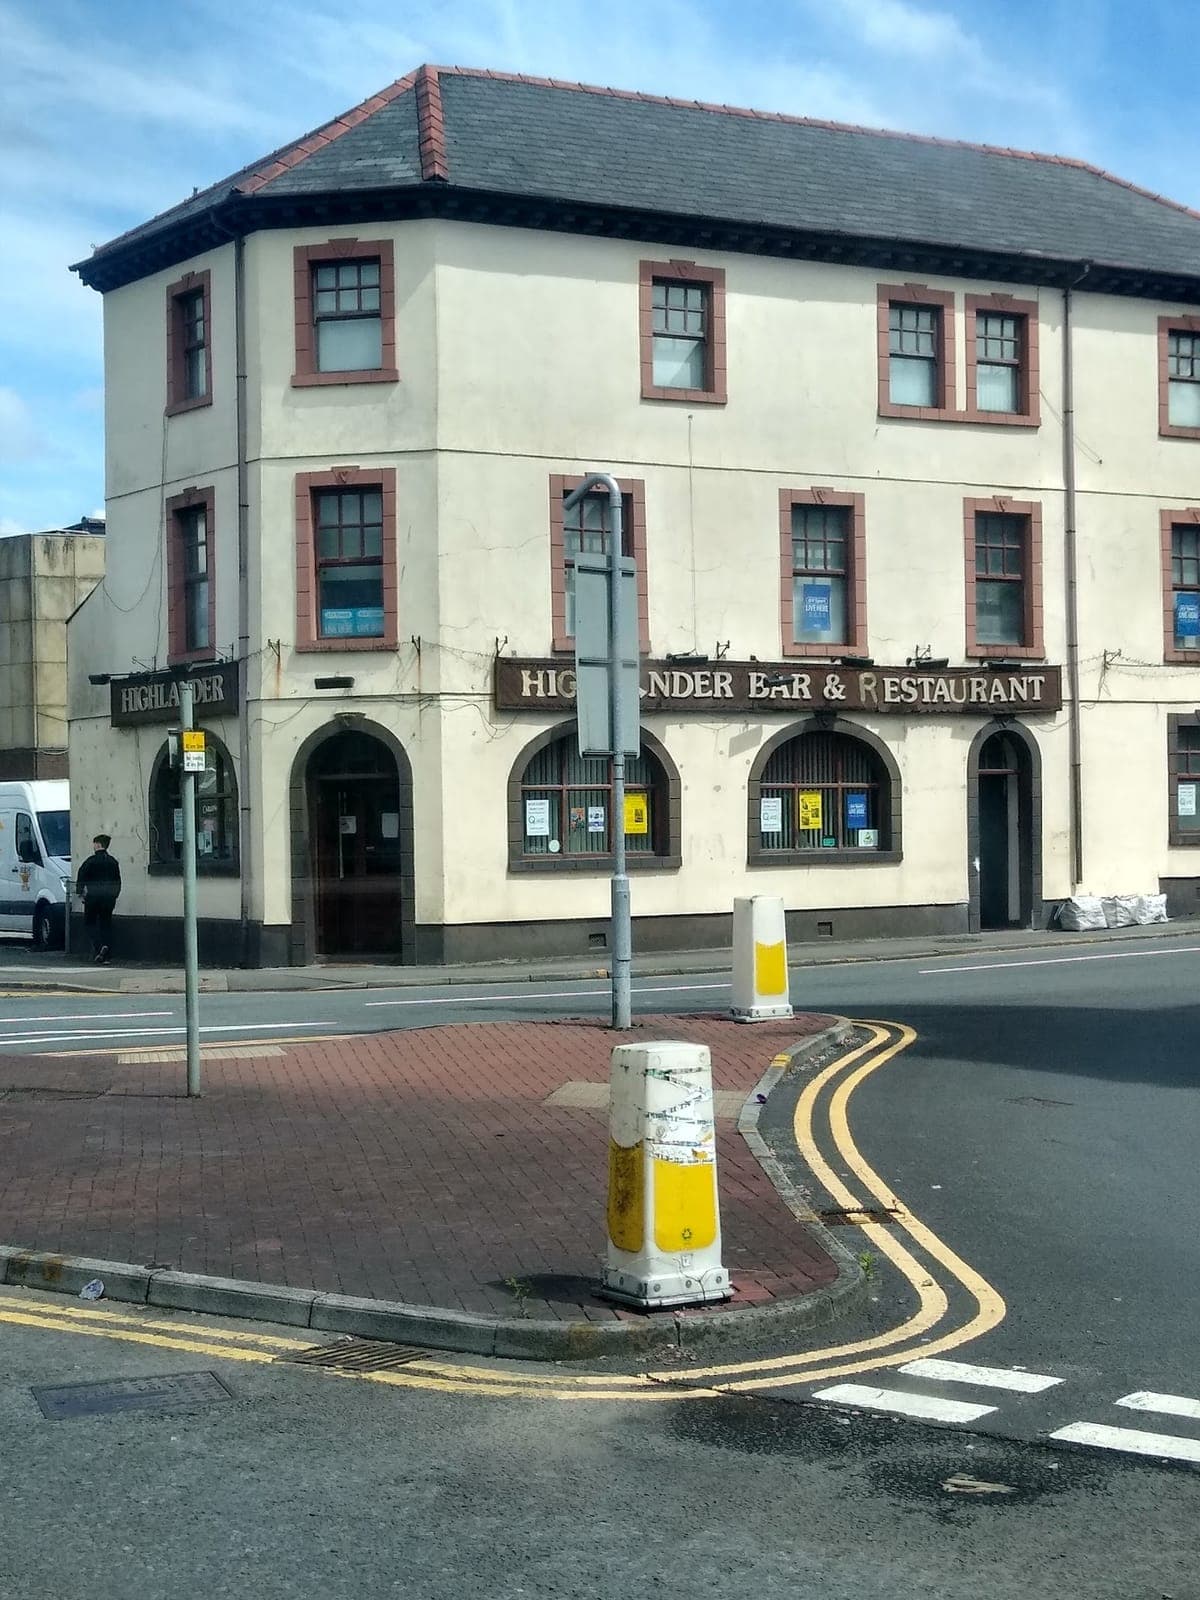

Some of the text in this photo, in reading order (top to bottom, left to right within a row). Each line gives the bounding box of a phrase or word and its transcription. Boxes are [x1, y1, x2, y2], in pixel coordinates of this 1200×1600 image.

[121, 674, 225, 713] HIGHLADER
[520, 669, 1046, 704] HIGNDER BAR & RESTAURANT
